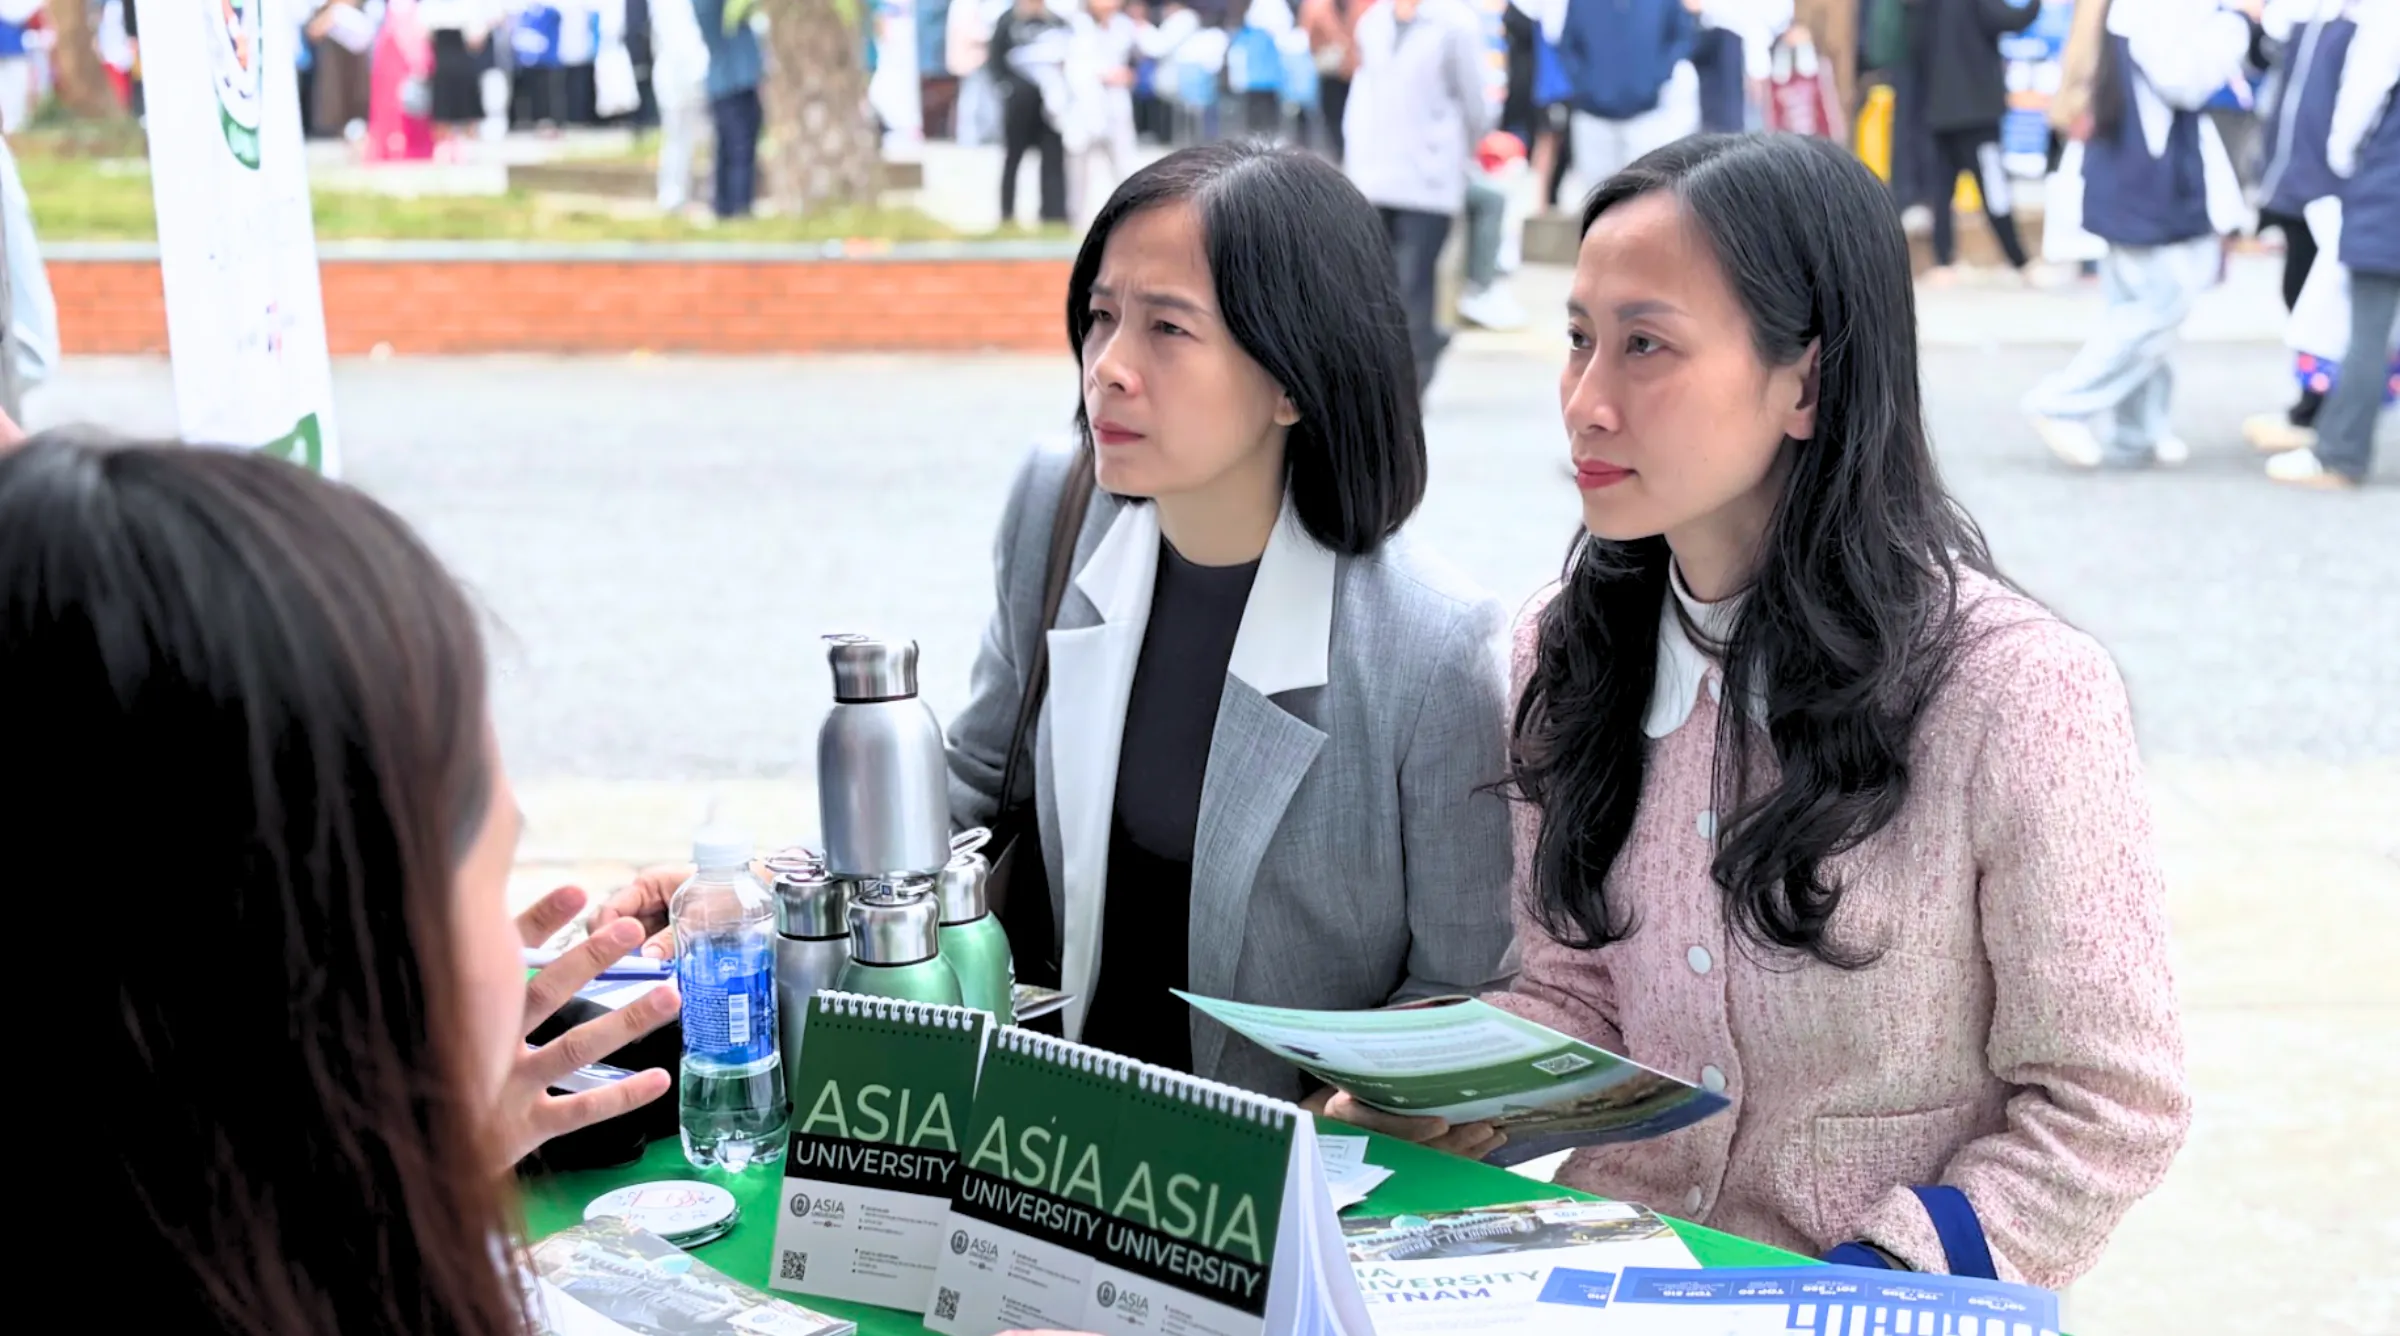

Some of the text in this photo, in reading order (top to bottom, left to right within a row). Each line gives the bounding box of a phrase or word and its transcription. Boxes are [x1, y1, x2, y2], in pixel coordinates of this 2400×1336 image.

[800, 1079, 958, 1152] ASIA
[796, 1140, 956, 1184] UNIVERSITY
[967, 1115, 1104, 1209] ASIA
[812, 1198, 845, 1214] ASIA
[961, 1174, 1102, 1241] UNIVERSITY
[1112, 1160, 1263, 1266] ASIA
[970, 1237, 999, 1257] ASIA
[1105, 1222, 1261, 1298] UNIVERSITY
[1355, 1267, 1397, 1279] IA
[1357, 1269, 1540, 1291] IVERSITY
[1117, 1290, 1150, 1311] ASIA
[1363, 1287, 1492, 1304] ETNAM
